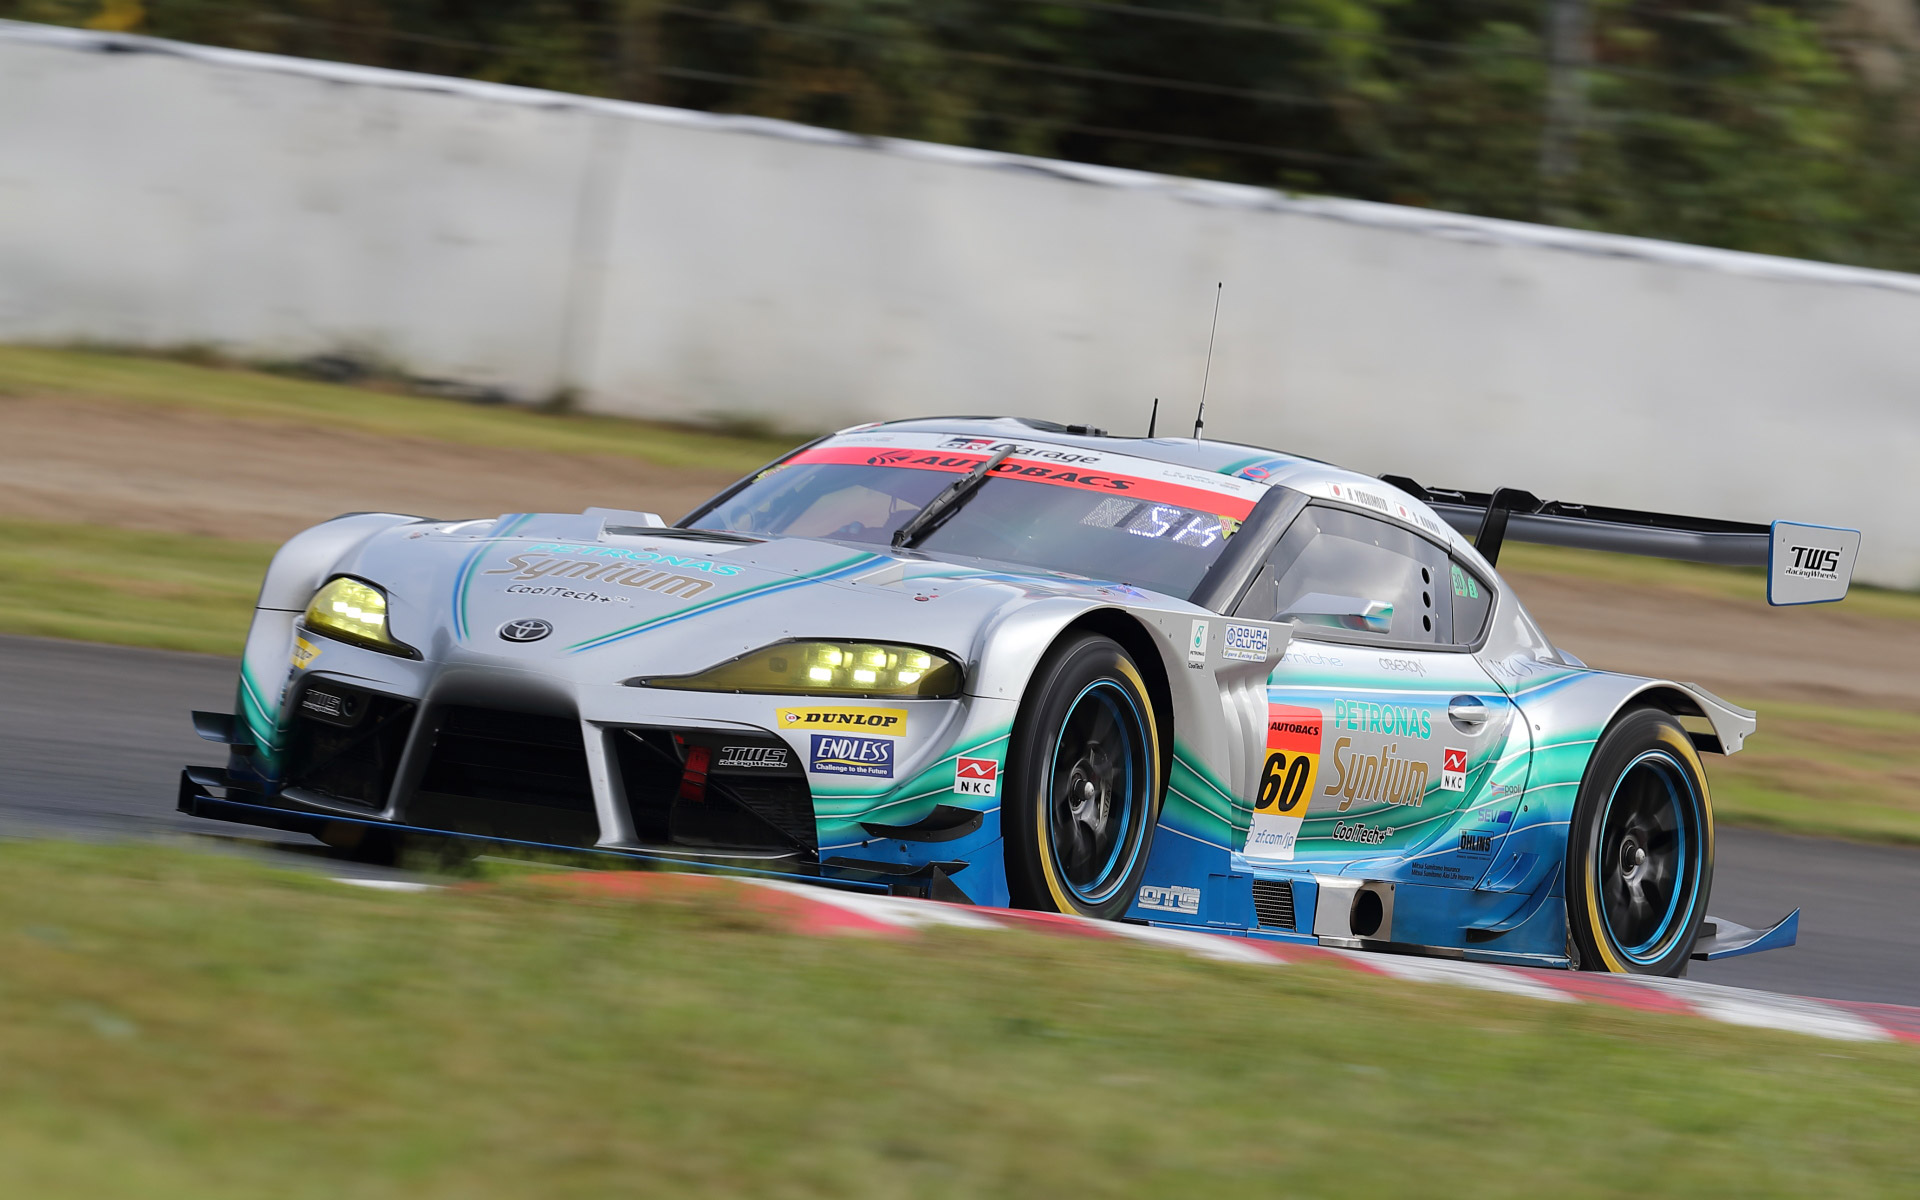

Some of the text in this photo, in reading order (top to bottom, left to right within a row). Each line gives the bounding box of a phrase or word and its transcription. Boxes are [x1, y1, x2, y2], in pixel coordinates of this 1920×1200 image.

[912, 456, 1135, 490] AUTOBACS
[525, 543, 744, 576] PETRONAS
[1790, 546, 1840, 572] TWS
[482, 553, 715, 600] Syntium
[1785, 568, 1837, 579] RacingWheels
[1237, 628, 1268, 641] OGURA
[1236, 638, 1267, 651] CLUTCH
[1281, 653, 1344, 667] rniche
[804, 713, 898, 727] DUNLOP
[1334, 698, 1431, 740] PETRONAS
[1270, 722, 1319, 736] AUTOBACS
[722, 747, 788, 764] TWS
[816, 737, 890, 762] ENDLESS
[816, 763, 848, 772] Challenge
[1323, 737, 1429, 812] Syntium
[960, 782, 991, 794] NKC
[1255, 752, 1310, 812] 60
[1444, 775, 1463, 789] NKC
[1478, 808, 1498, 822] SEV
[1255, 829, 1294, 849] zf.com/jp
